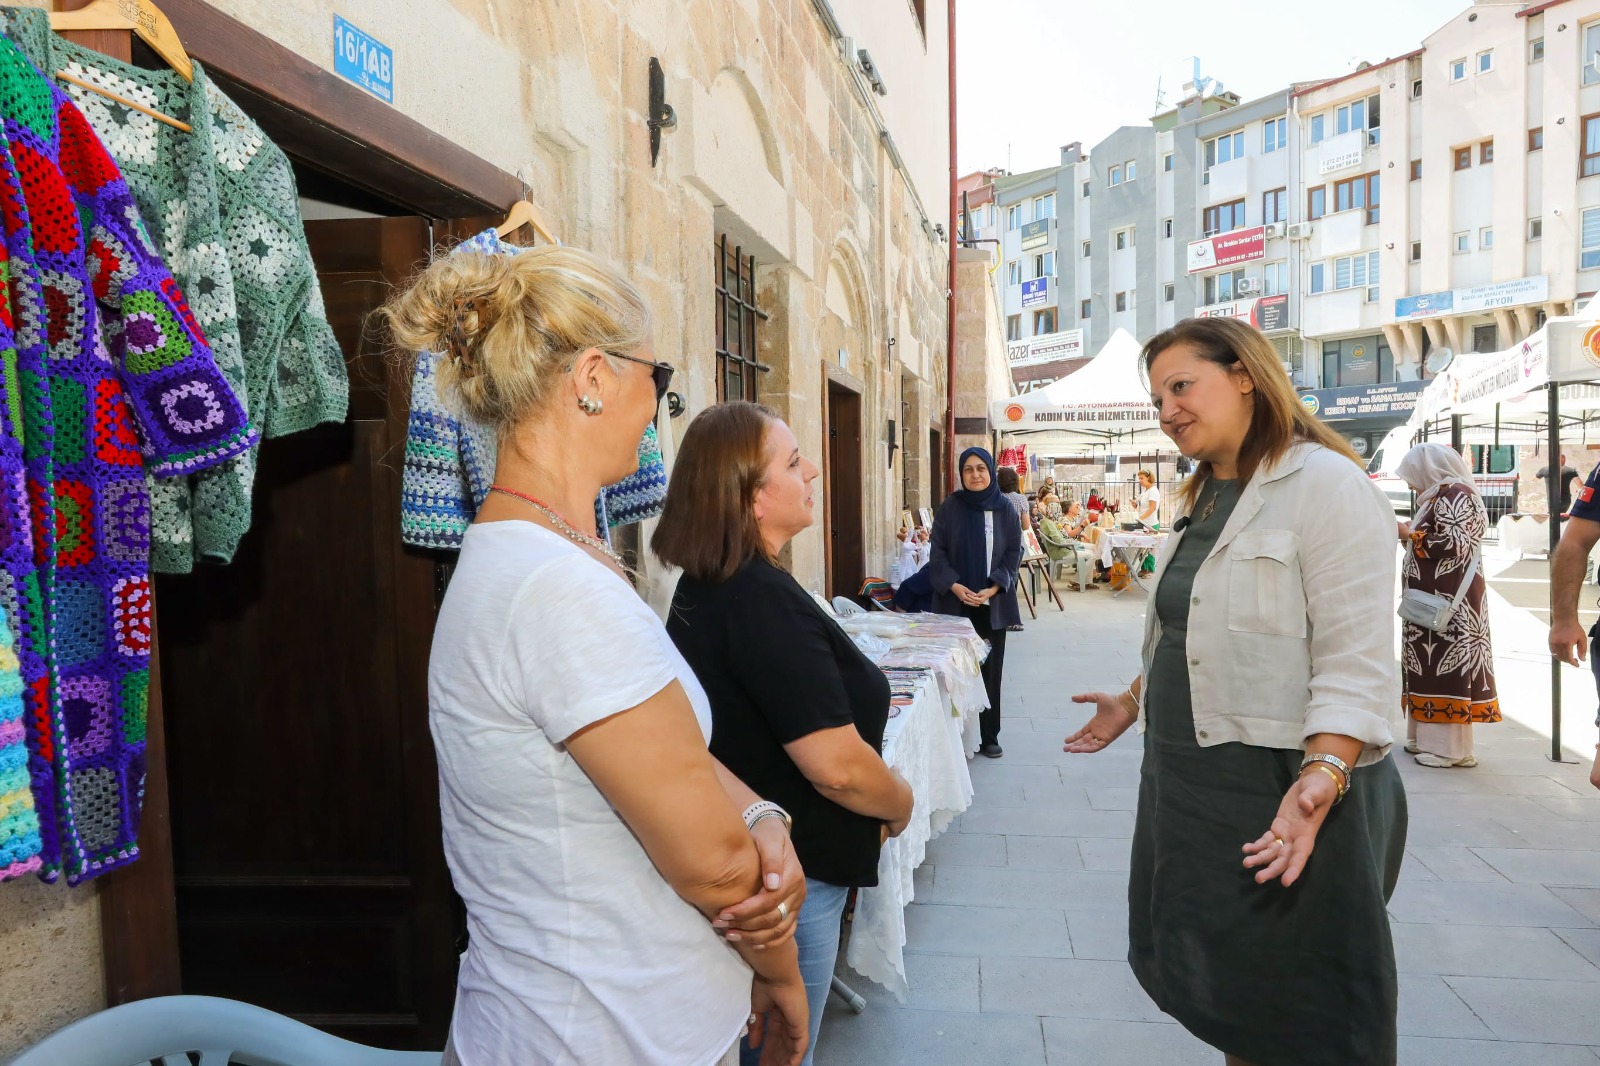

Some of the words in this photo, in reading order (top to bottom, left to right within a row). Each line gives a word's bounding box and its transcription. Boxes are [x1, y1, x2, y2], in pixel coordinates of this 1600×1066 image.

[336, 25, 391, 84] 16/1AB
[1485, 295, 1513, 307] AFYON
[1336, 396, 1360, 406] ESNAF
[1358, 403, 1389, 413] KEFALET
[1034, 412, 1062, 422] KADIN
[1064, 411, 1076, 422] VE
[1078, 409, 1096, 422] AİLE
[1099, 408, 1150, 421] HİZMETLERİ
